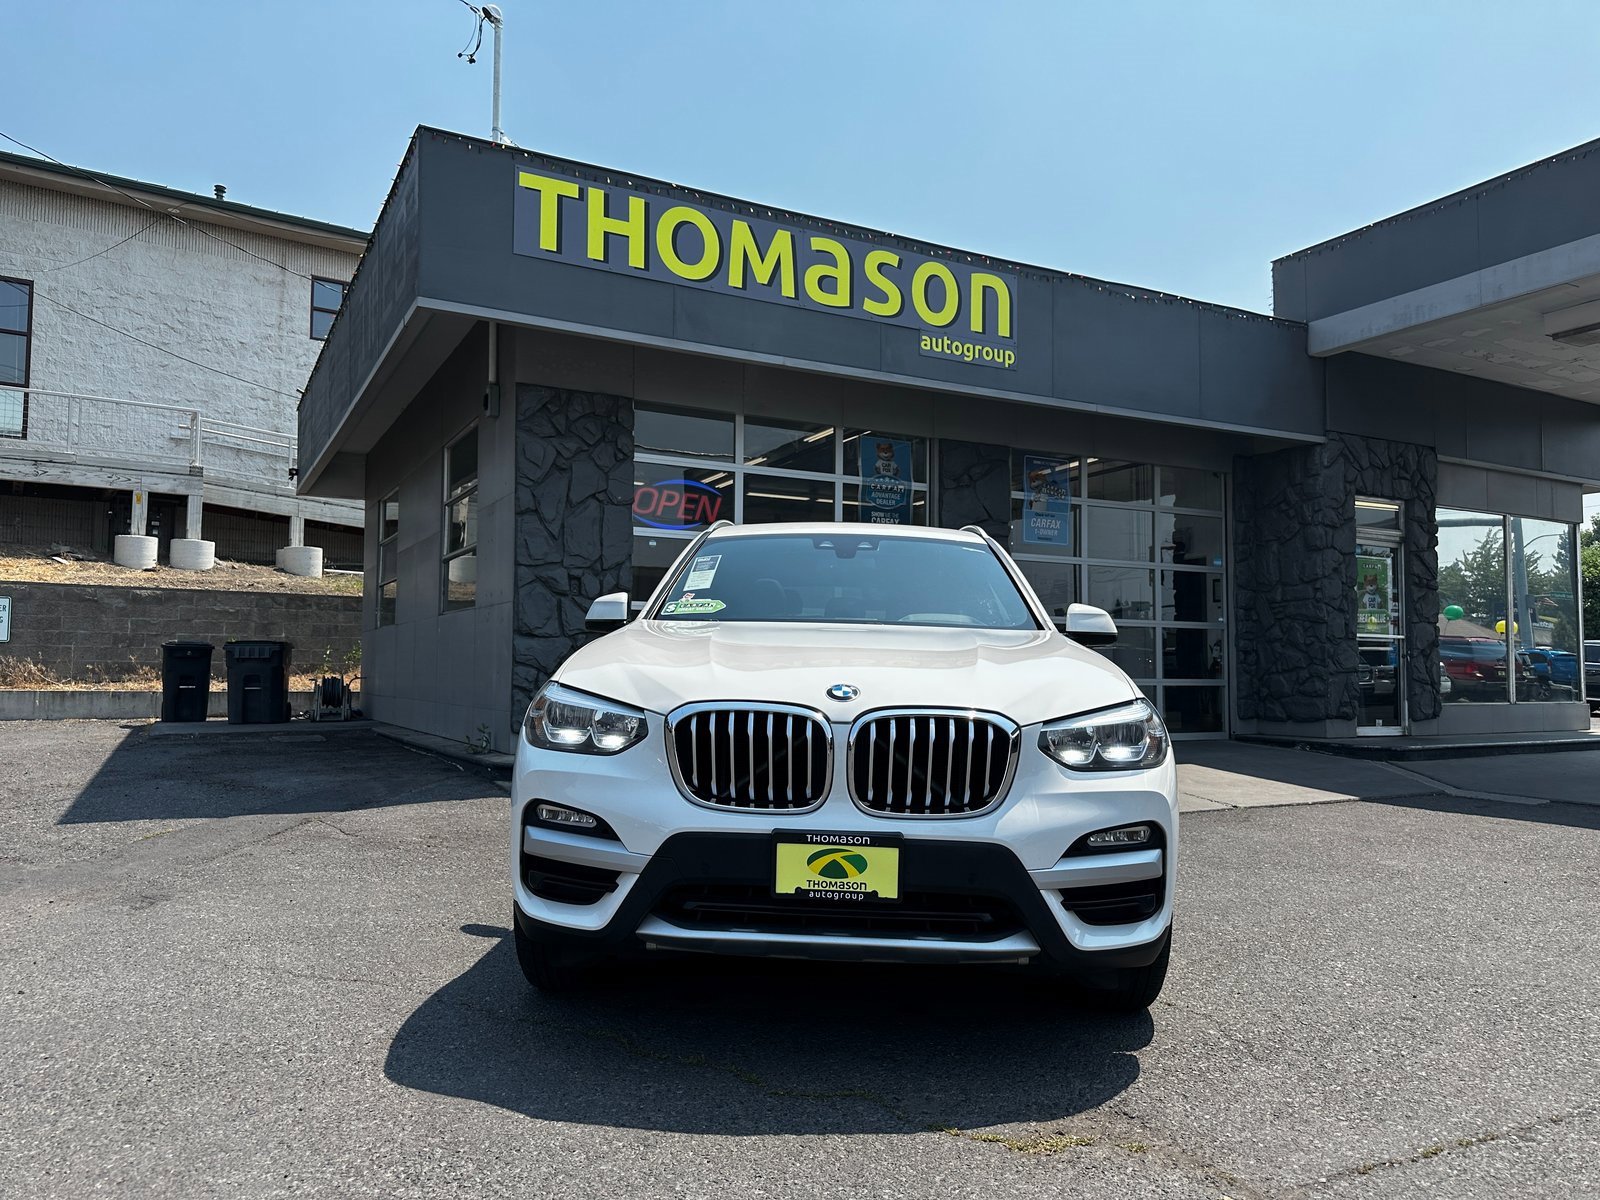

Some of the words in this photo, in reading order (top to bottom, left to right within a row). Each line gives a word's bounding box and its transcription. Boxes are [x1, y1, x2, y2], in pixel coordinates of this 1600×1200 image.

[920, 335, 1015, 367] autogroup
[871, 492, 901, 500] ADVANTAGE
[633, 487, 722, 524] OPEN
[1030, 518, 1061, 528] CARFAX
[808, 890, 864, 901] autogroup
